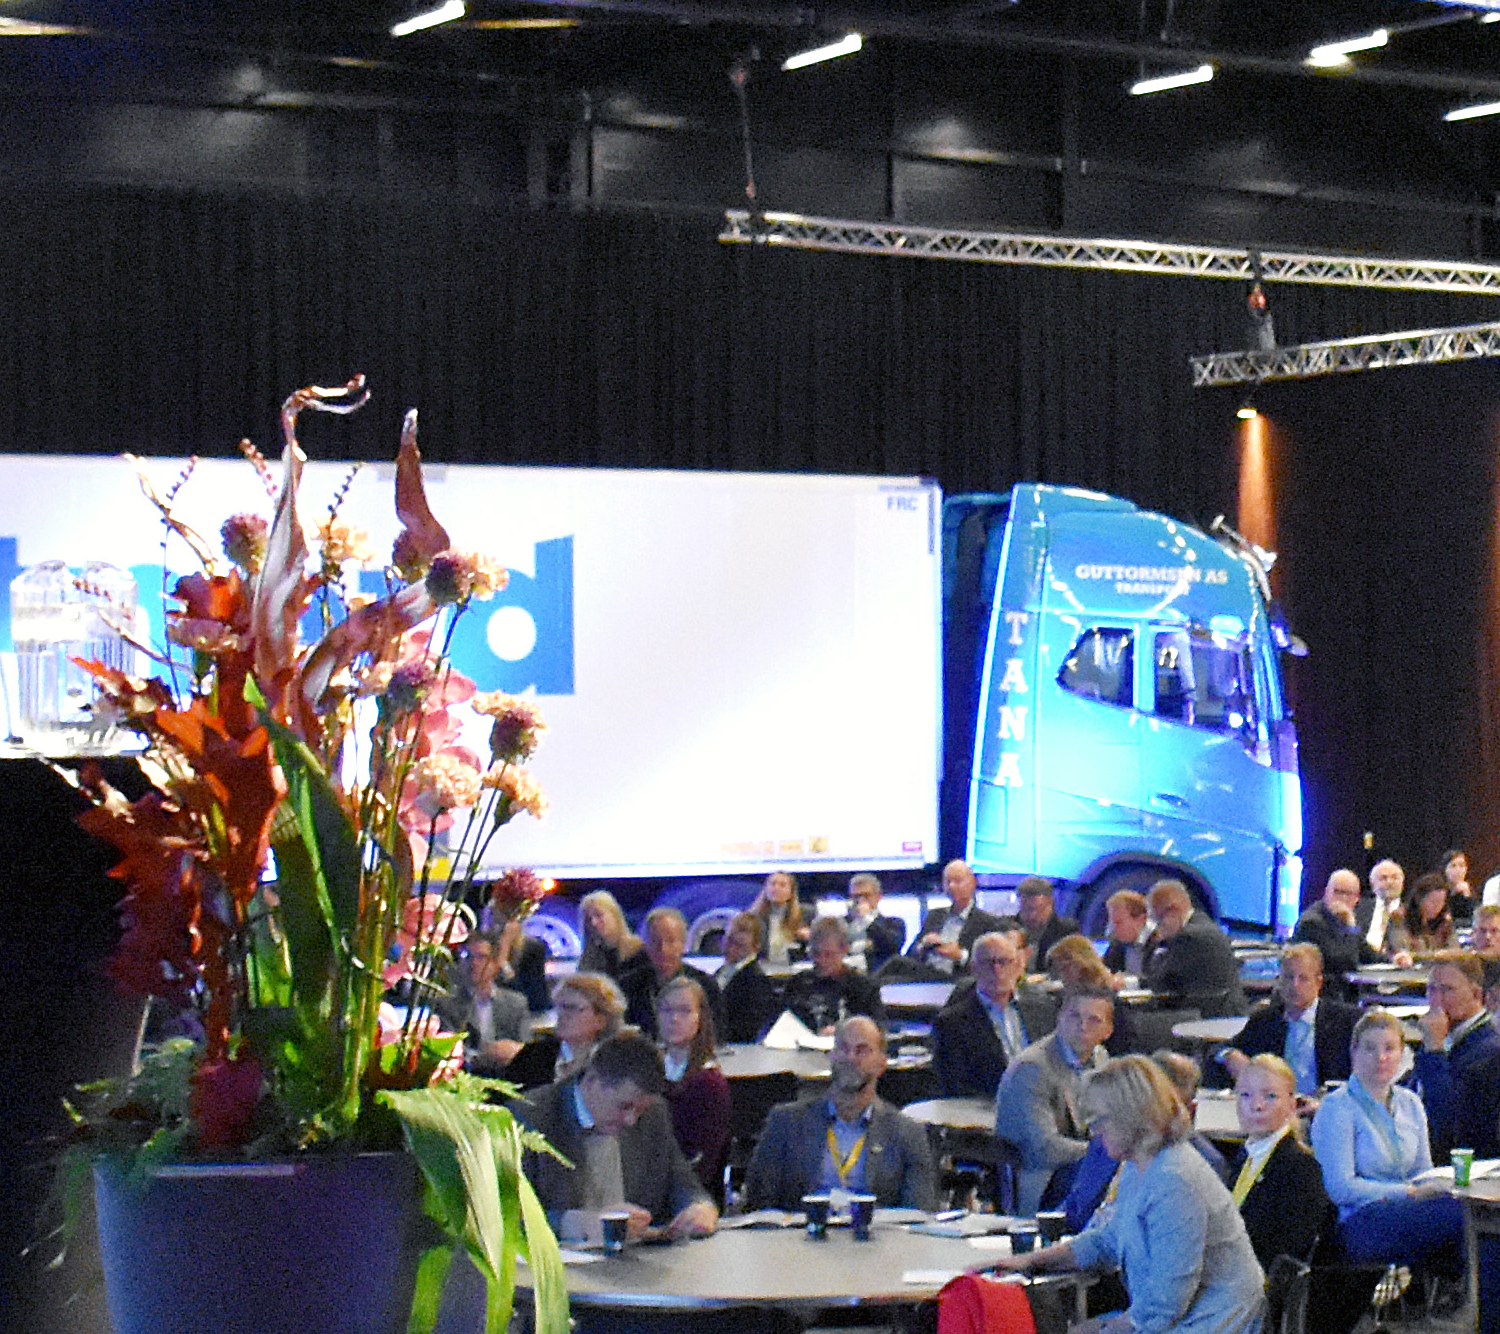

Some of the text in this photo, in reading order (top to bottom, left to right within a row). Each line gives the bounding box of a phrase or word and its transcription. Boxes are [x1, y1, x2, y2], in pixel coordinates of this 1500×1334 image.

[887, 496, 918, 511] FRC
[1204, 569, 1229, 585] AS
[1116, 581, 1190, 596] TRANSP
[994, 610, 1029, 787] TANA
